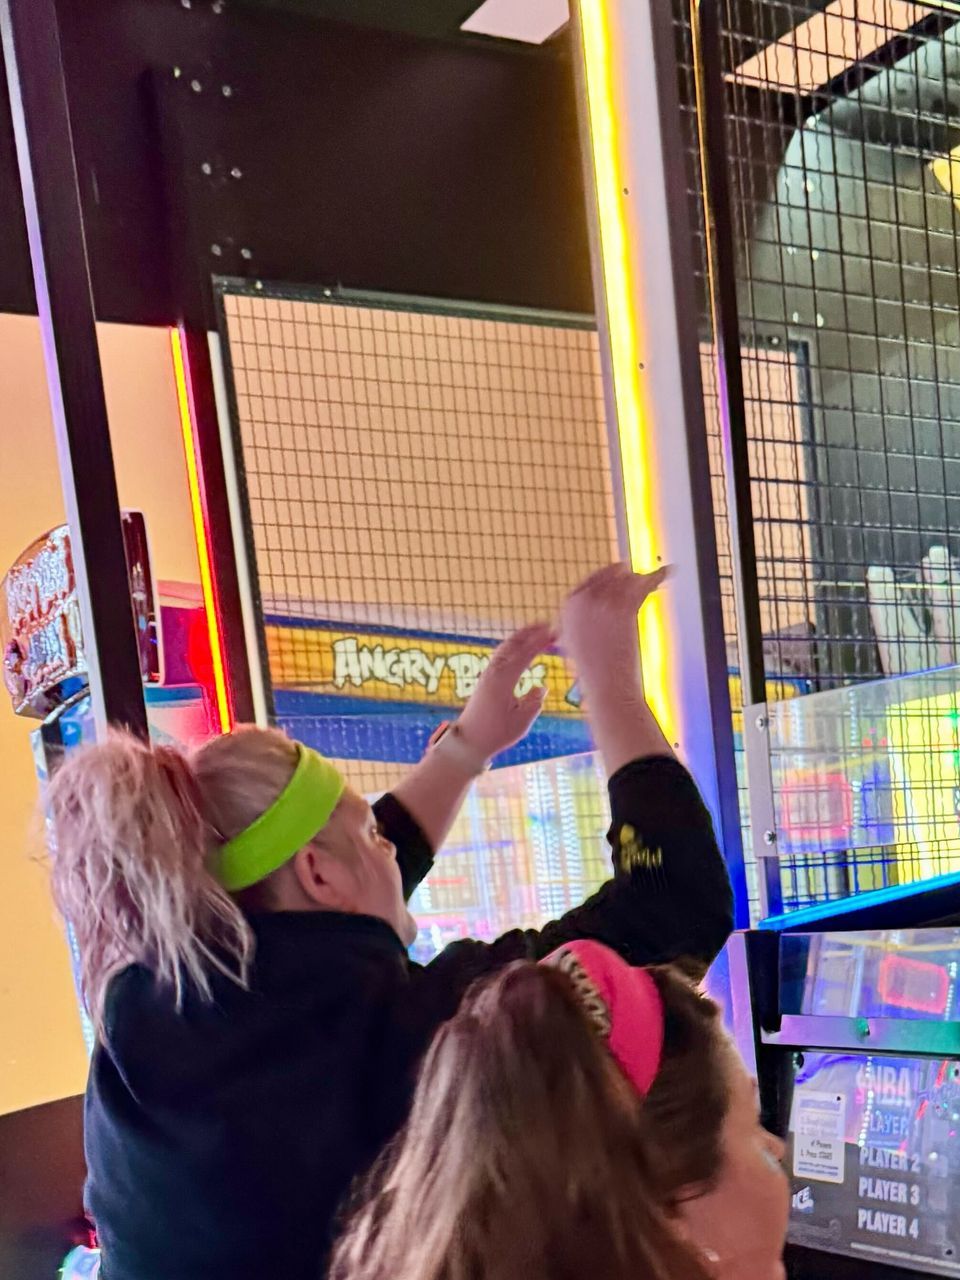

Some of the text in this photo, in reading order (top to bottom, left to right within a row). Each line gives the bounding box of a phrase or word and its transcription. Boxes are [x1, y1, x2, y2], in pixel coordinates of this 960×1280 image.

[331, 637, 446, 694] ANGRY
[859, 1147, 921, 1173] PLAYER 2
[858, 1177, 920, 1206] PLAYER 3
[857, 1208, 919, 1239] PLAYER 4
